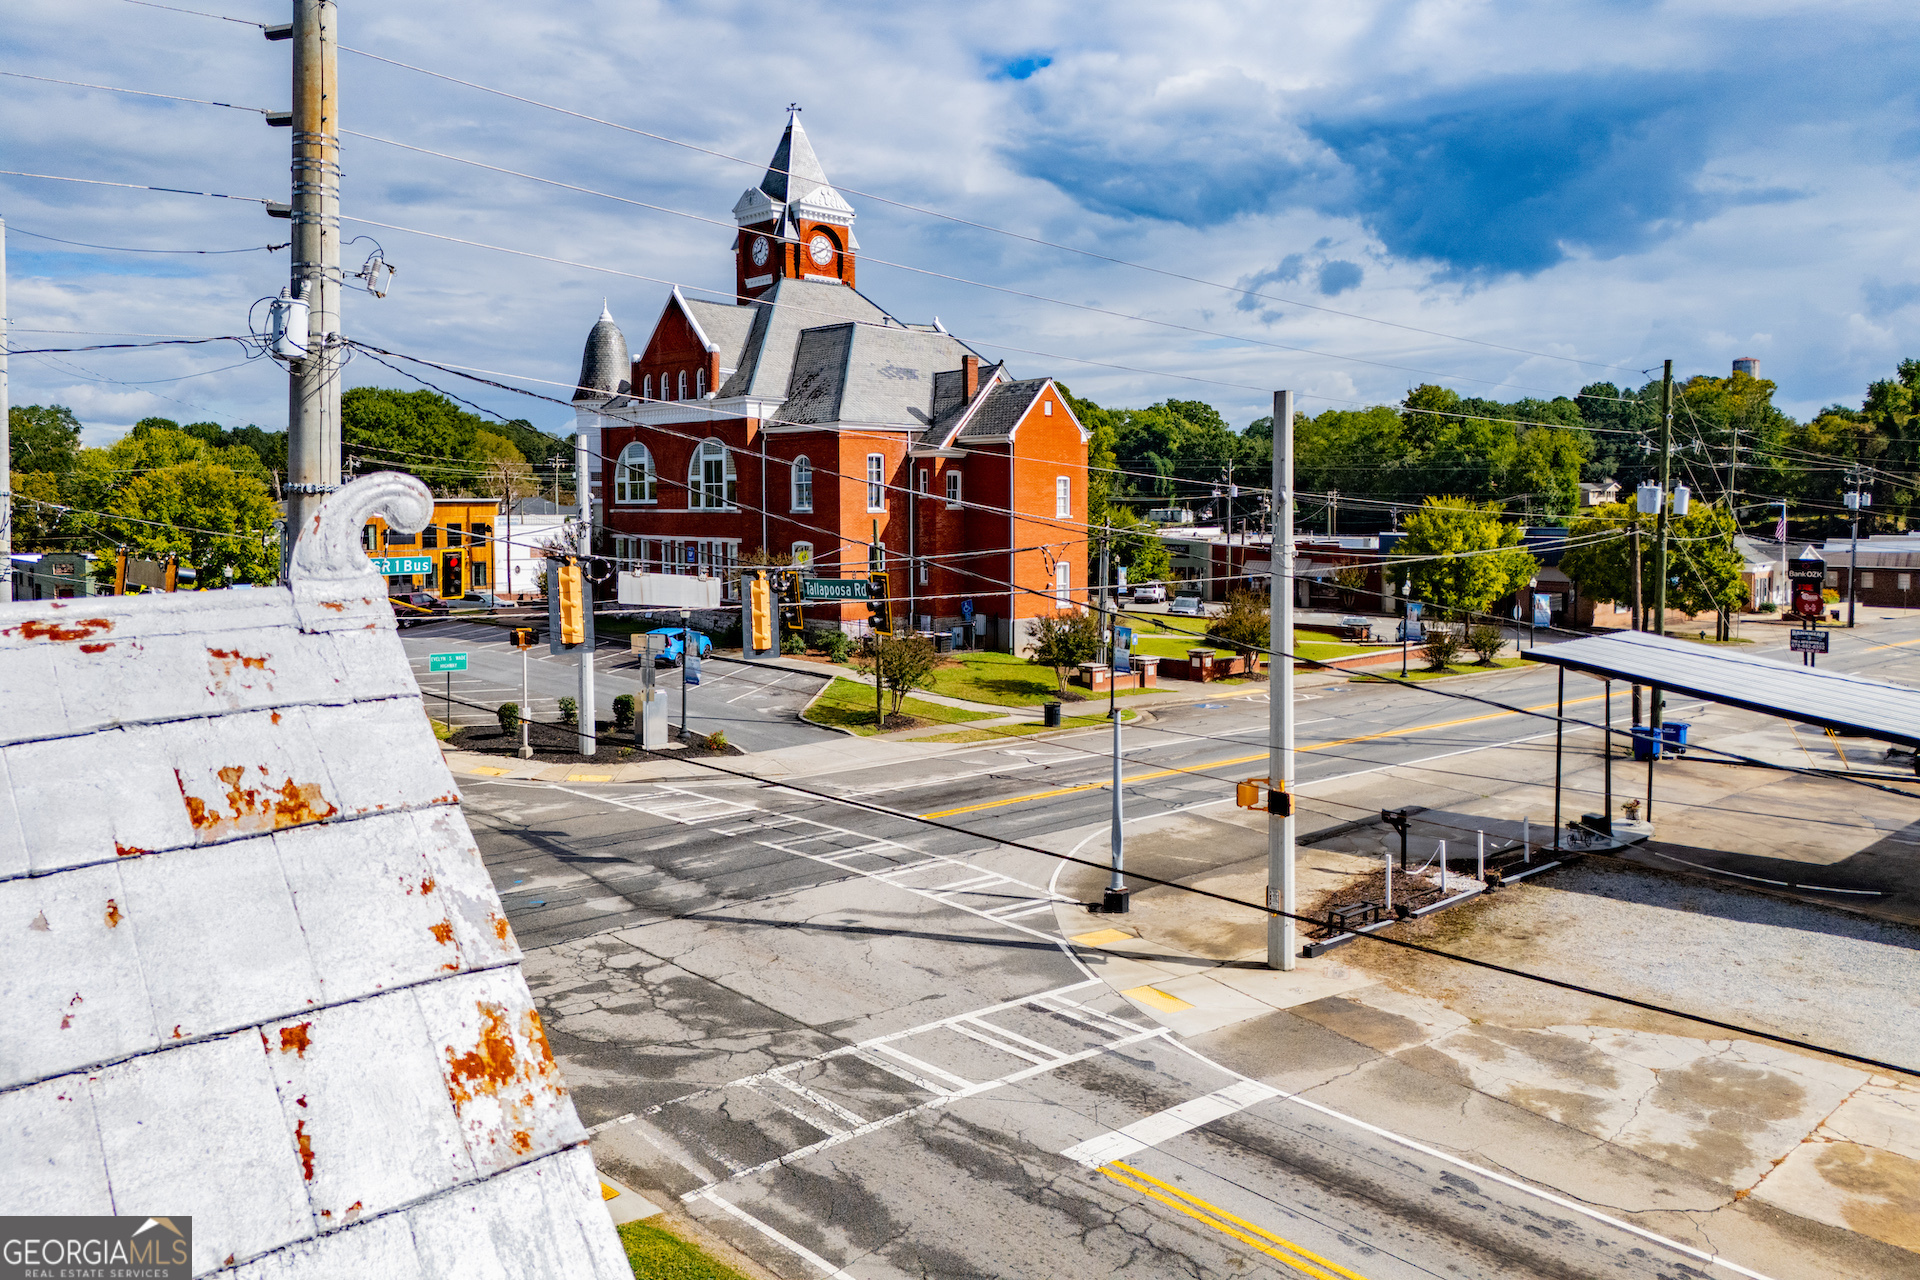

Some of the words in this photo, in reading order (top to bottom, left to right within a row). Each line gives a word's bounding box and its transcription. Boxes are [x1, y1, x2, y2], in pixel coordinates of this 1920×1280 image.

[404, 560, 429, 573] Bus
[1789, 570, 1806, 578] Bank
[1806, 570, 1822, 578] OZK
[805, 582, 852, 598] Tallapoosa
[854, 583, 868, 597] Rd
